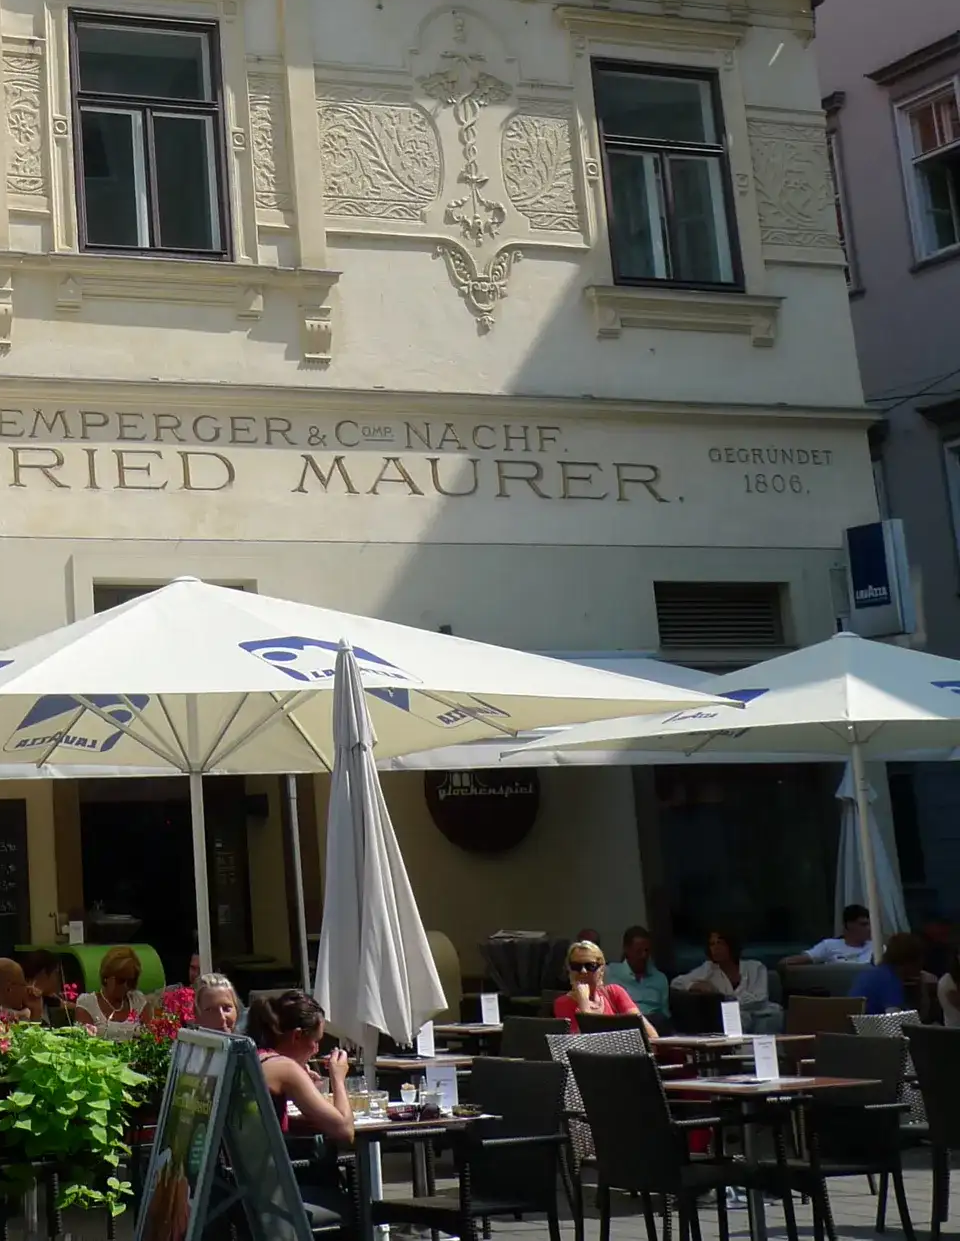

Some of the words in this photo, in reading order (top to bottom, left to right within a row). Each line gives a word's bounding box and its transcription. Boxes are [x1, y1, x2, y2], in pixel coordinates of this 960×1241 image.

[305, 425, 328, 448] &
[403, 420, 569, 453] NACHF.
[707, 444, 833, 466] GEGRÜNDET
[290, 452, 685, 504] MAURER.
[743, 473, 811, 495] 1806.
